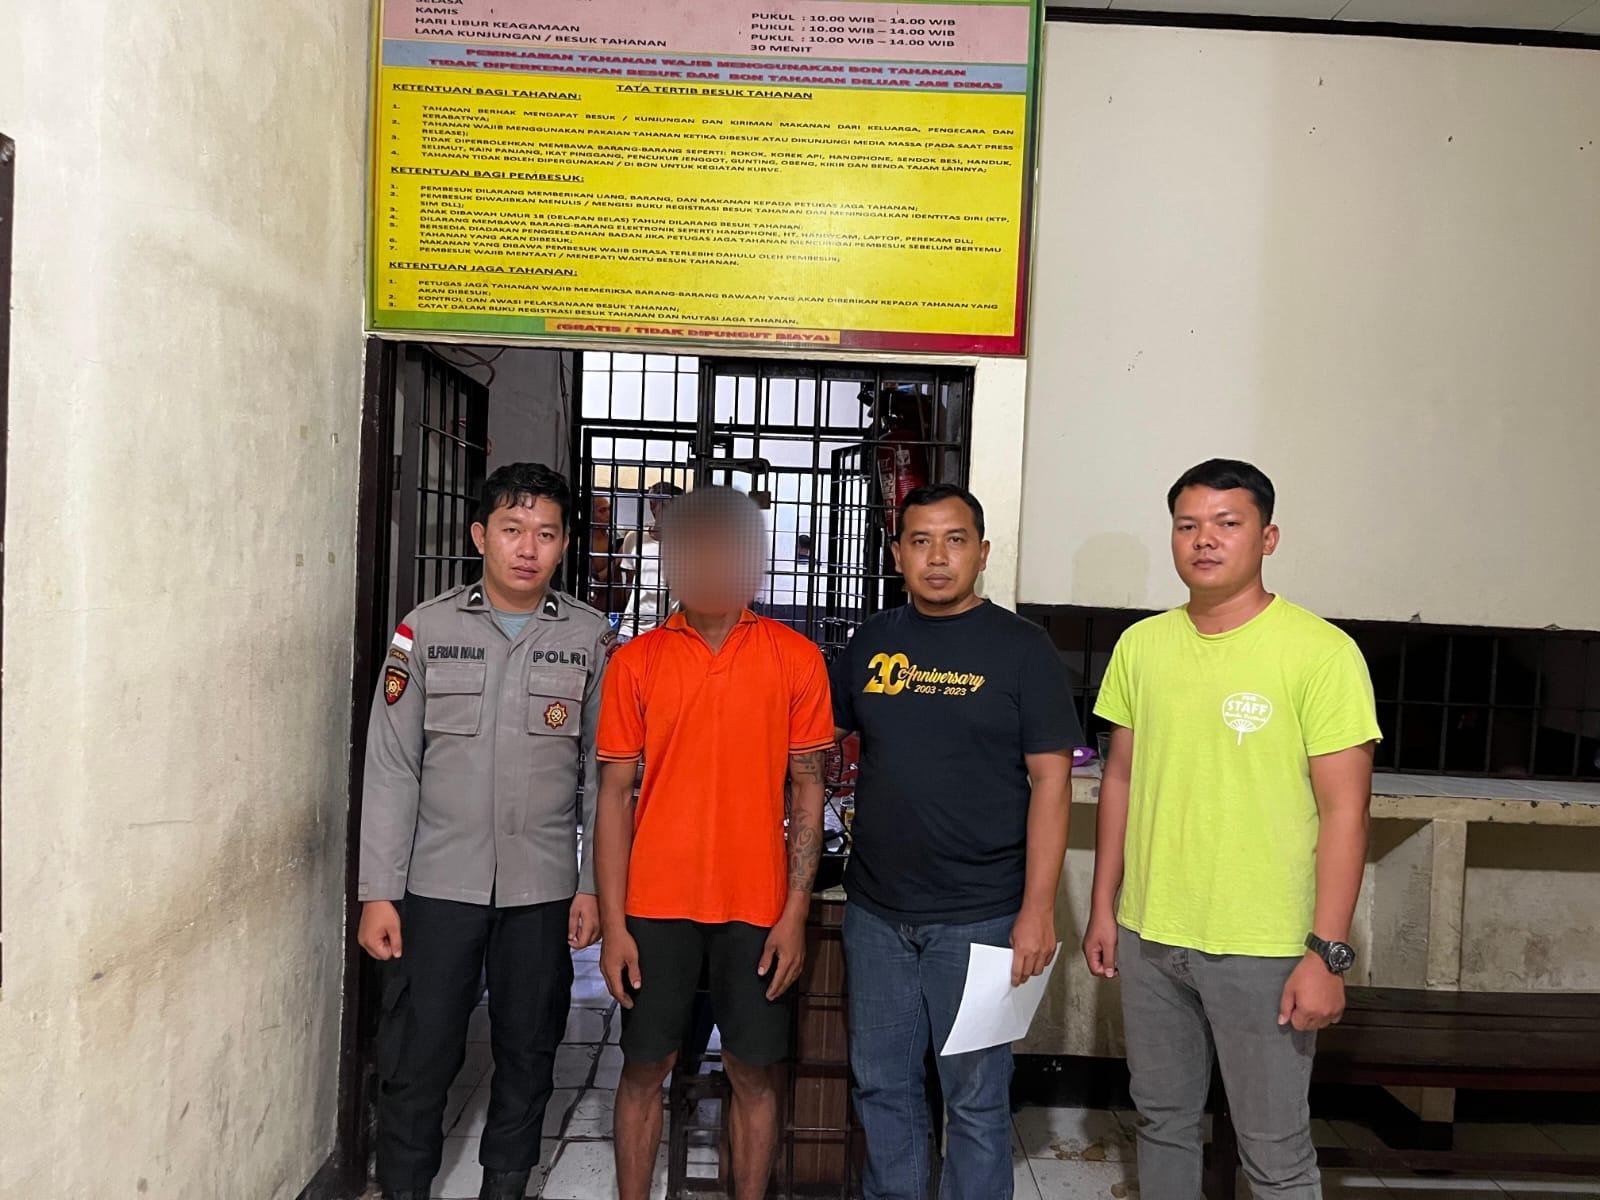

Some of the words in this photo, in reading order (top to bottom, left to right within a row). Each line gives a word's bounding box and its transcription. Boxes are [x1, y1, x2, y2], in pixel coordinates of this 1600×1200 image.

[415, 6, 458, 15] KAMIS
[415, 17, 447, 25] HARI
[451, 19, 488, 27] LIBUR
[493, 21, 580, 32] KEAGAMAAN
[848, 16, 875, 24] WIB
[414, 27, 453, 35] LAMA
[457, 30, 541, 40] KUNJUNGAN
[555, 35, 596, 43] BESUK
[601, 37, 666, 46] TAHANAN
[890, 28, 925, 36] 14.00
[769, 45, 812, 53] MENIT
[392, 82, 471, 95] KETENTUAN
[476, 88, 507, 97] BAGI
[616, 84, 650, 93] TATA
[655, 86, 698, 95] TERTIB
[702, 88, 743, 97] BESUK
[748, 90, 812, 100] TAHANAN
[390, 166, 469, 177] KETENTUAN
[474, 170, 505, 179] BAGI
[388, 261, 466, 272] KETENTUAN
[471, 264, 504, 273] JAGA
[532, 650, 587, 667] POLRI
[863, 653, 909, 696] 20
[898, 665, 985, 693] Anniversary
[914, 684, 937, 694] 2003
[943, 686, 967, 696] 2023
[1227, 699, 1269, 716] STAFF
